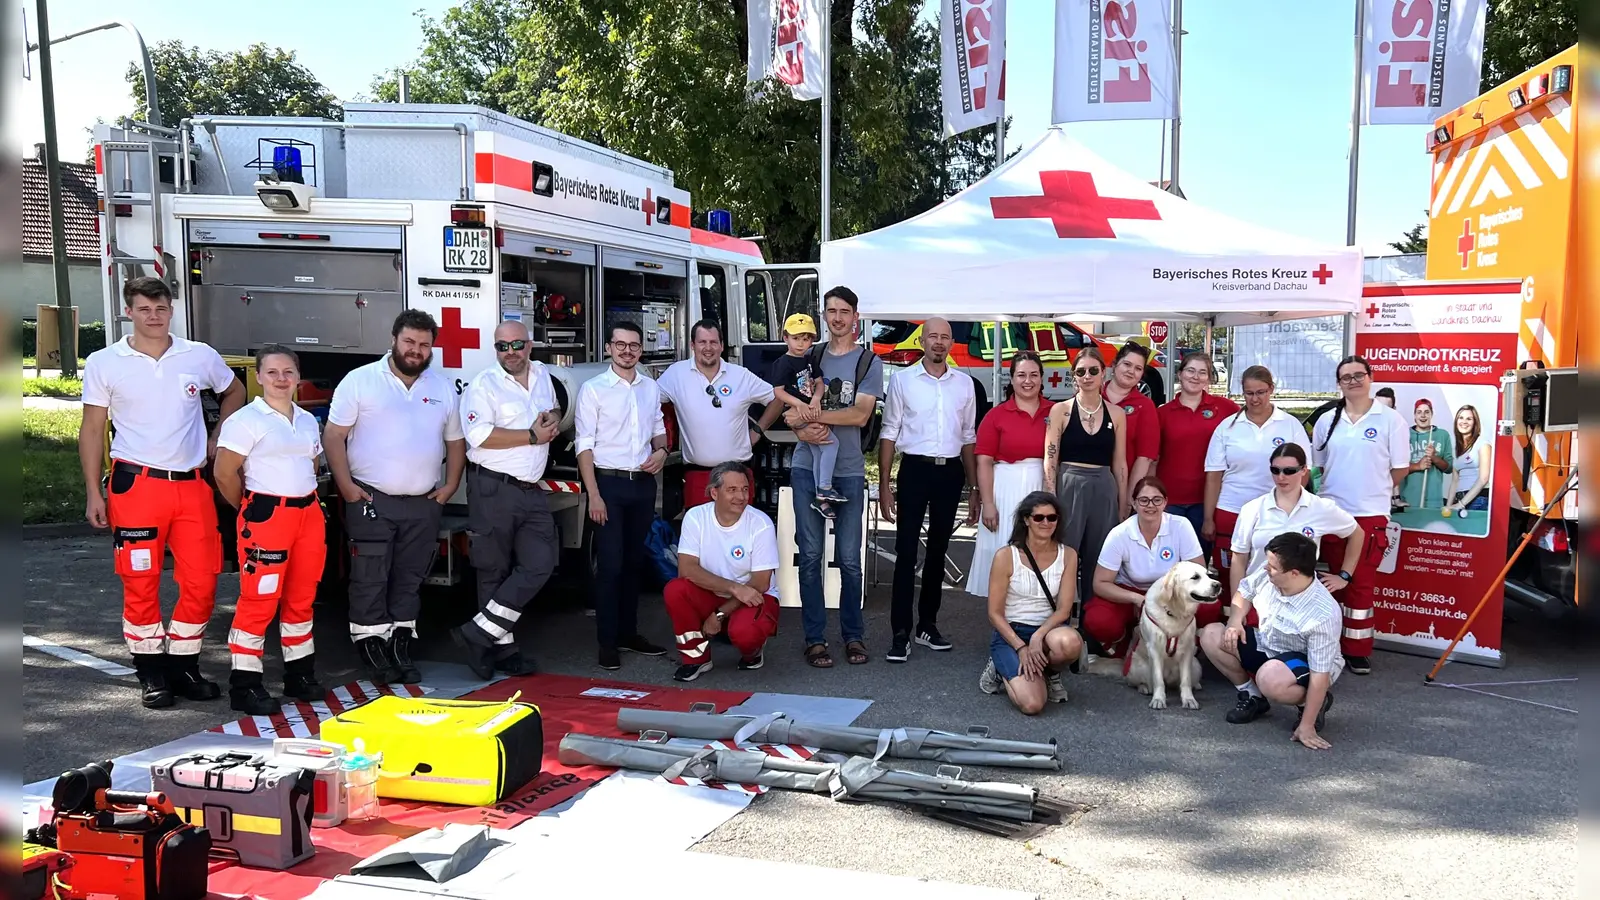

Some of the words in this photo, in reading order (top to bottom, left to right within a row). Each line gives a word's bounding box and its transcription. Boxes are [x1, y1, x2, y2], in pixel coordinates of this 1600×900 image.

[1431, 19, 1447, 104] DEUTSCHLANDS
[554, 171, 598, 200] Bayerisches
[599, 183, 619, 206] Rotes
[620, 188, 640, 211] Kreuz
[454, 231, 480, 248] DAH
[448, 249, 466, 265] RK
[470, 250, 487, 266] 28
[1152, 268, 1229, 281] Bayerisches
[1232, 268, 1268, 279] Rotes
[1272, 268, 1308, 279] Kreuz
[1212, 282, 1272, 291] Kreisverband
[1273, 282, 1308, 291] Dachau
[422, 290, 434, 298] RK
[1471, 315, 1503, 324] Dachau
[1150, 326, 1167, 336] STOP
[1361, 348, 1502, 362] JUGENDROTKREUZ
[1396, 362, 1441, 374] kompetent
[1443, 364, 1450, 372] &
[1451, 364, 1493, 375] engagiert
[1433, 538, 1450, 547] klein
[1424, 548, 1473, 559] rauskommen!
[1408, 554, 1451, 566] Gemeinsam
[1451, 560, 1470, 568] aktiv
[1403, 564, 1430, 573] werden
[1459, 570, 1474, 578] mit!
[1382, 587, 1411, 600] 08131
[1413, 591, 1419, 600] /
[1420, 592, 1456, 605] 3663-0
[1372, 600, 1468, 620] w.kvdachau.brk.de
